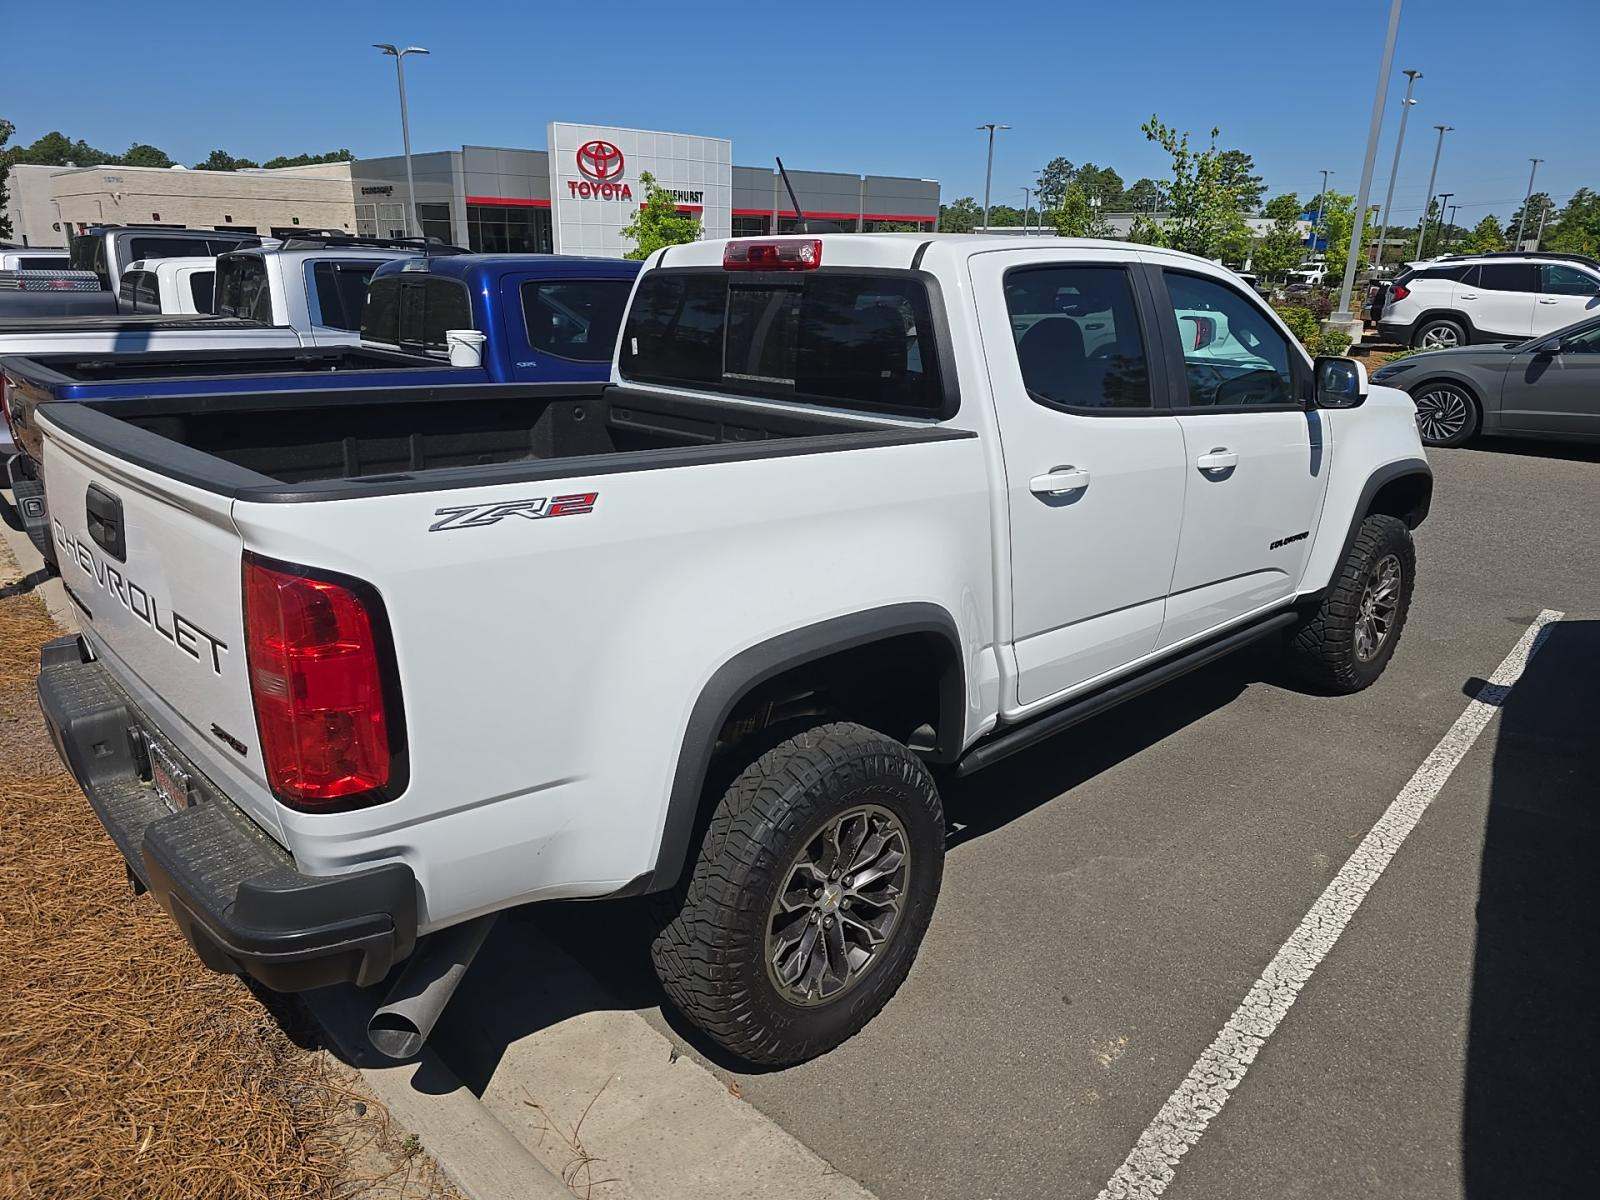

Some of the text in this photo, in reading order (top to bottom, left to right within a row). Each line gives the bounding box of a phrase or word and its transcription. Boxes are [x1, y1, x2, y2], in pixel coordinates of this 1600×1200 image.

[567, 181, 632, 201] TOYOTA
[429, 492, 599, 532] ZR2
[53, 517, 229, 676] CHEVROLET
